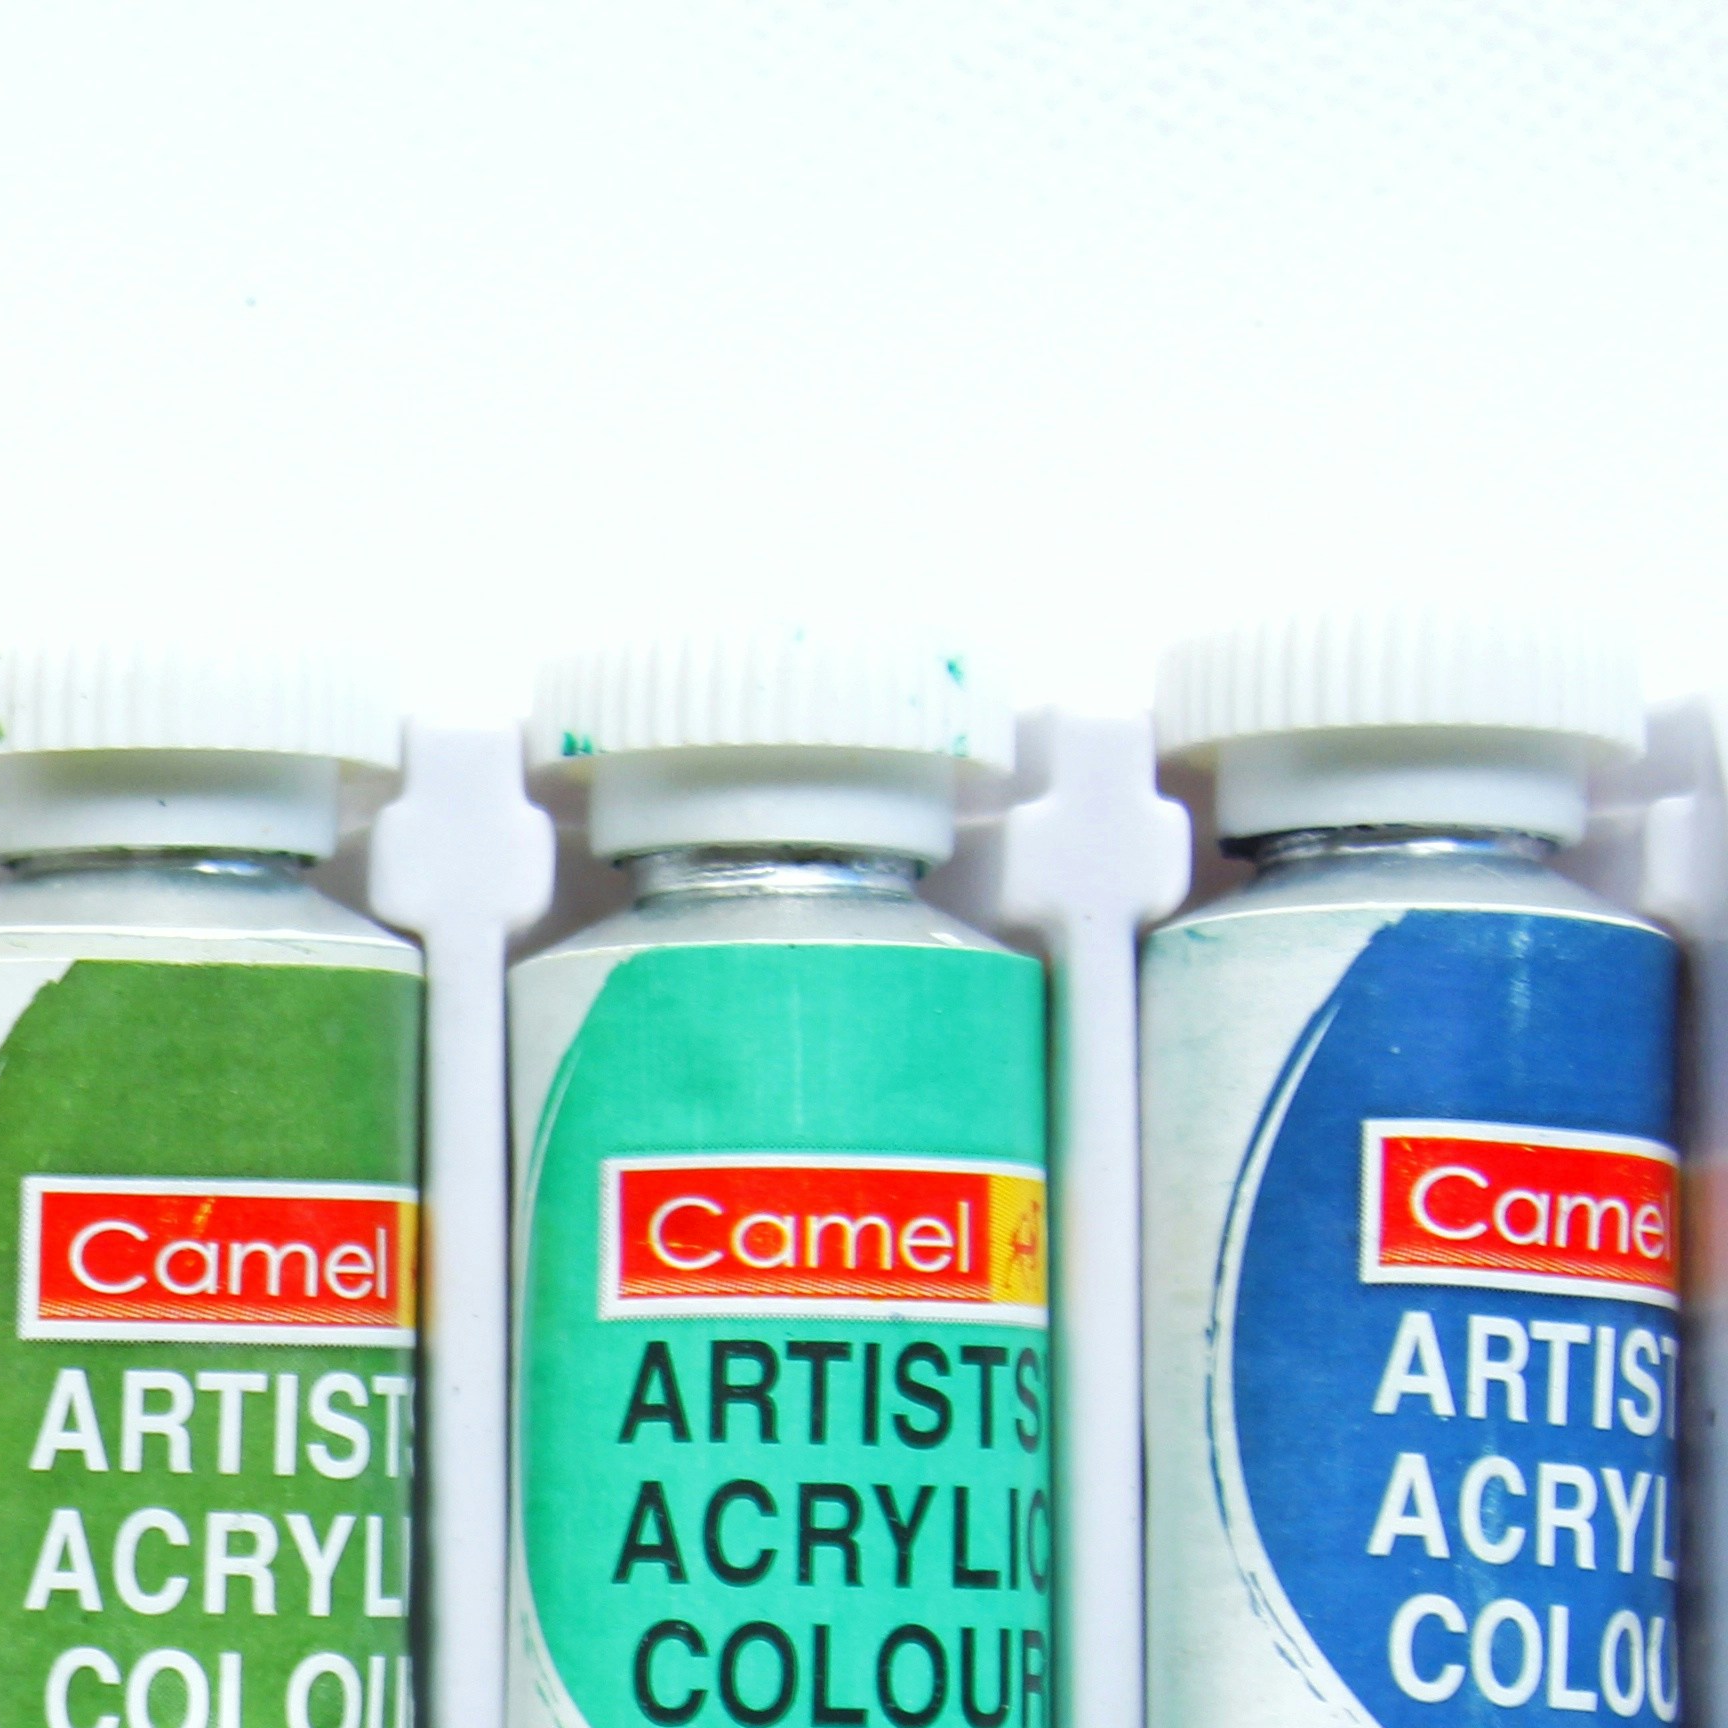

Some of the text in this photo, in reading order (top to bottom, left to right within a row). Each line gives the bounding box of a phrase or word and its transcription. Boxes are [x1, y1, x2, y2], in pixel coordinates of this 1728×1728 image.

[68, 1220, 388, 1301] Camel
[649, 1197, 972, 1274] Camel
[1409, 1164, 1674, 1260] Camel
[28, 1367, 416, 1482] ARTIST
[618, 1340, 1044, 1456] ARTISTS
[611, 1479, 1050, 1592] ACRYLIC
[1367, 1451, 1679, 1582] ACRYL
